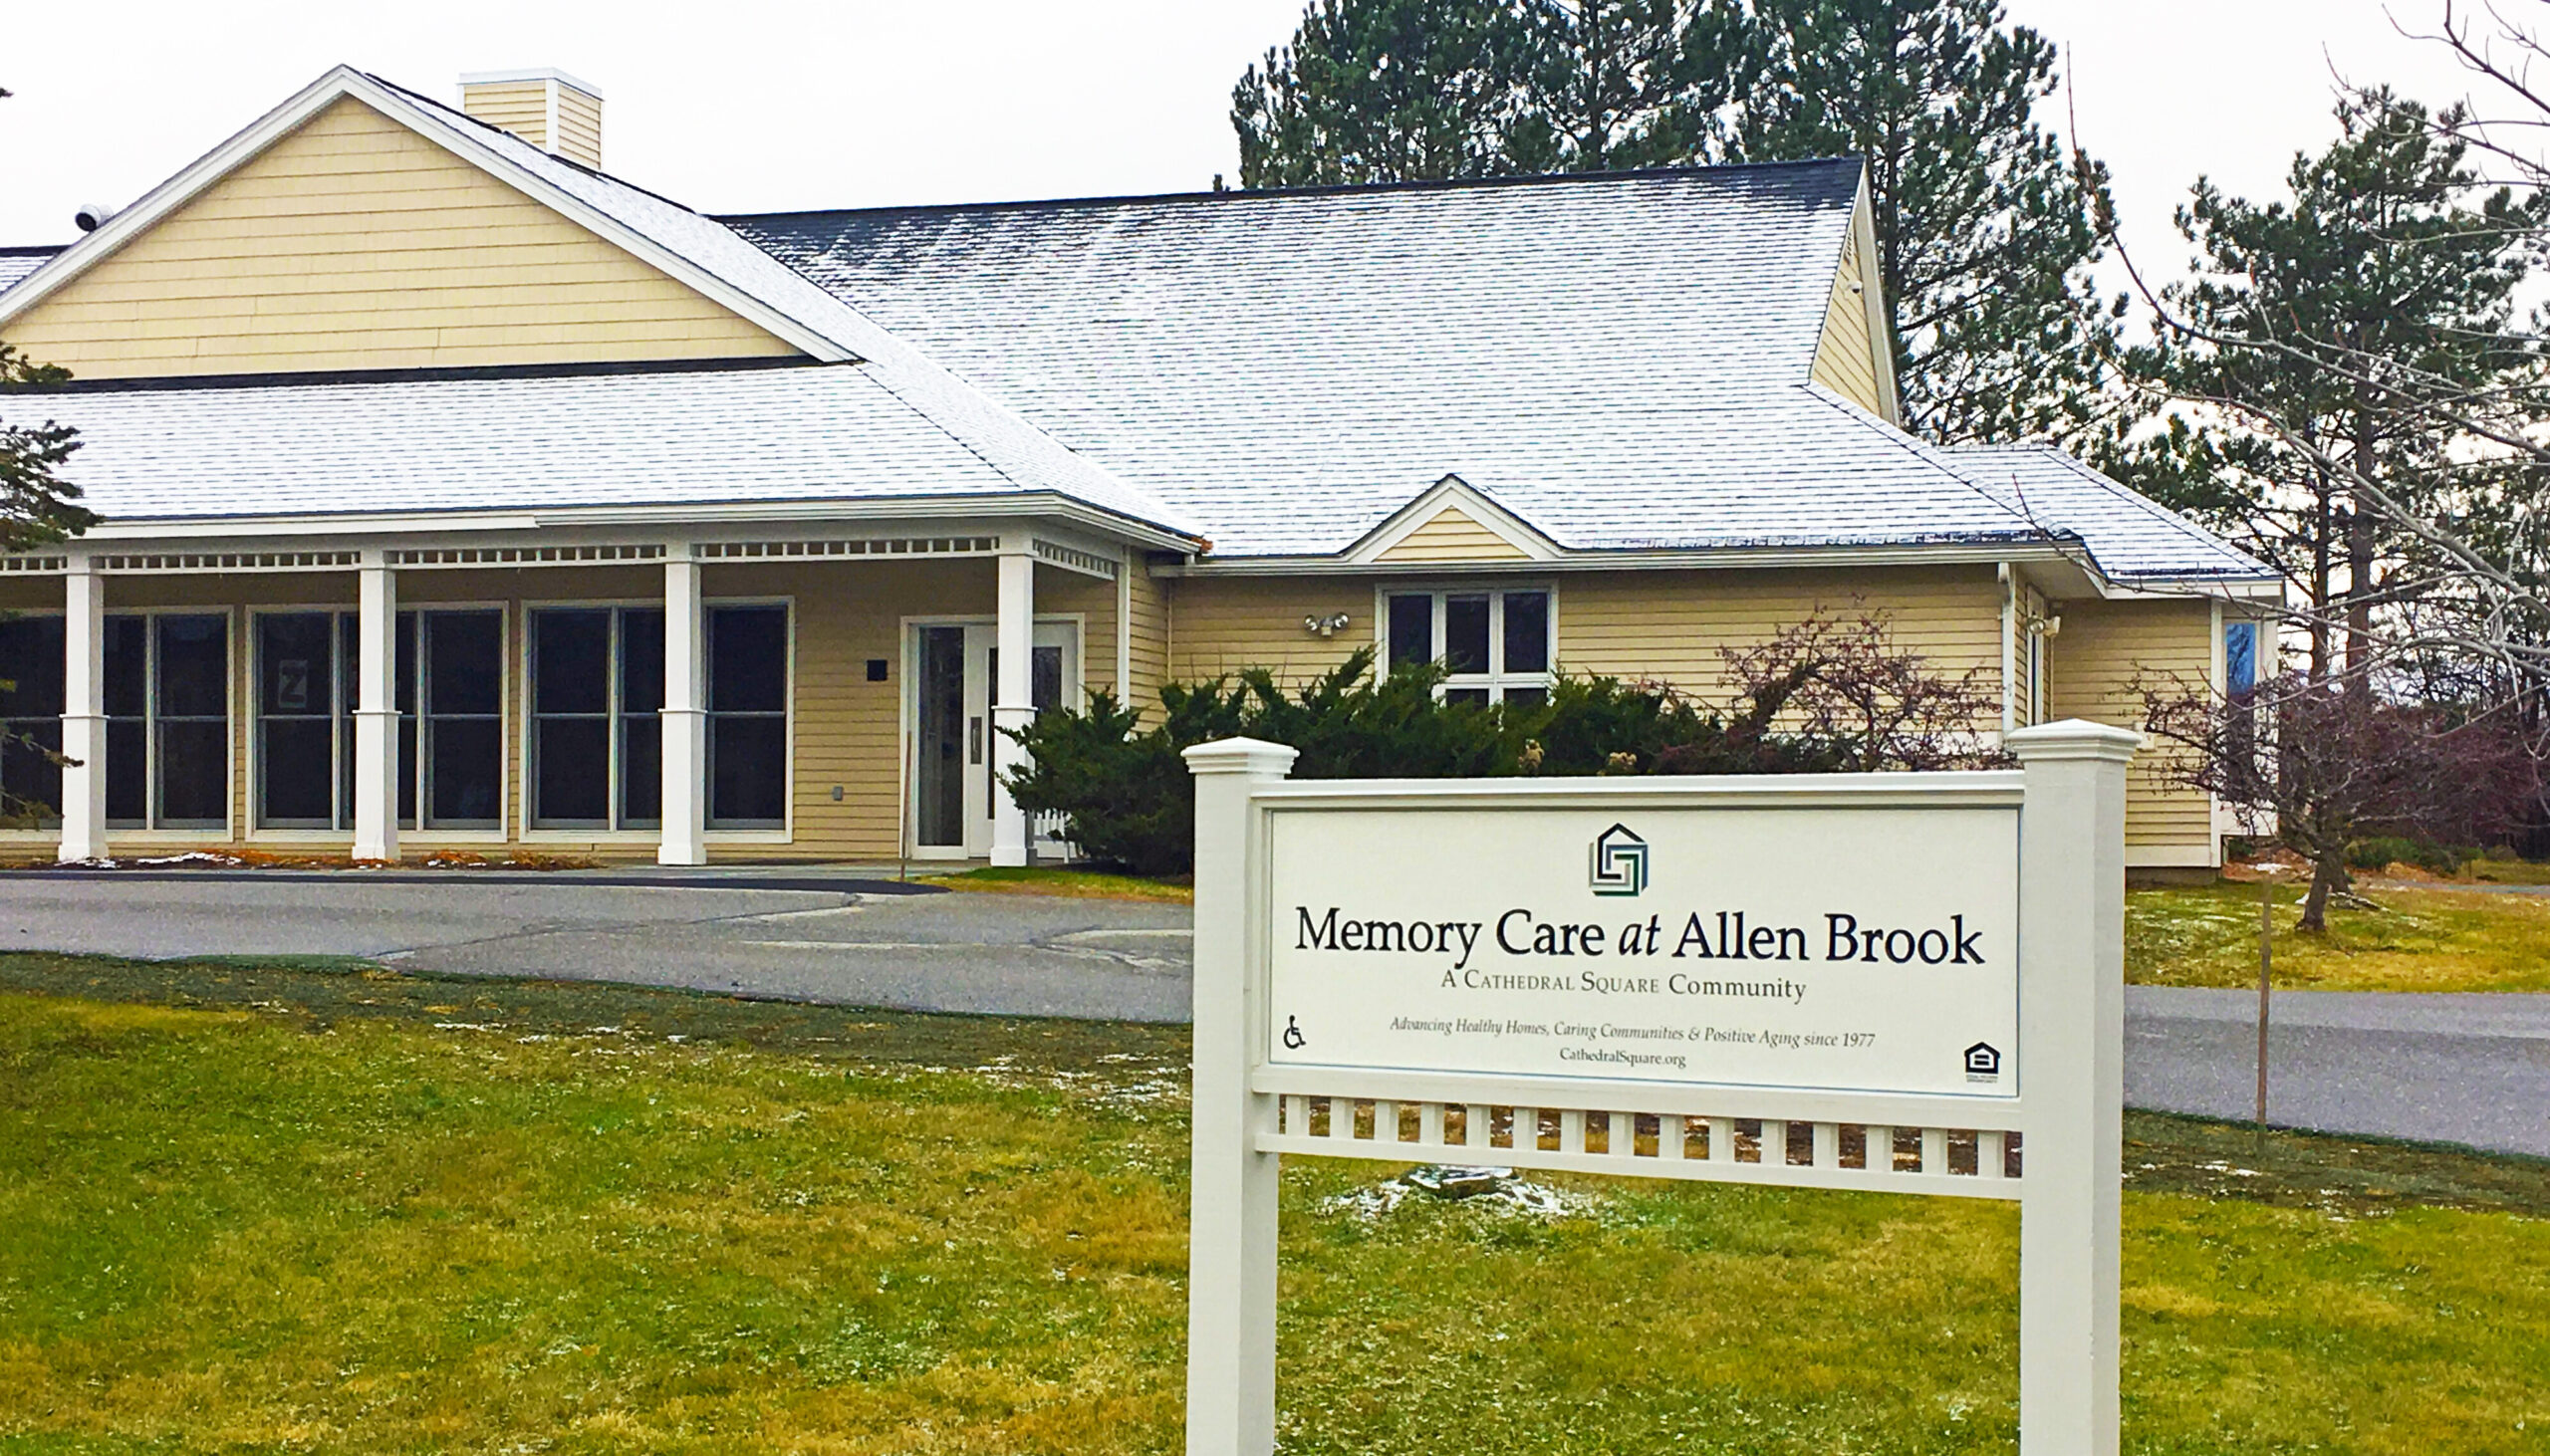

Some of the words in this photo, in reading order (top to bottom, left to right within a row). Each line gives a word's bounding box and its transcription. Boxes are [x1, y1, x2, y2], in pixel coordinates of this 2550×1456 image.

[1295, 906, 1482, 969] Memory
[1496, 908, 1606, 956] Care
[1619, 913, 1660, 956] at
[1671, 910, 1810, 960] Allen
[1824, 913, 1985, 965] Brook
[1440, 969, 1457, 988] A
[1464, 969, 1575, 991] CATHEDRAL
[1581, 971, 1659, 994] SQUARE
[1668, 973, 1807, 1005] Community
[1390, 1016, 1452, 1036] Advancing
[1456, 1018, 1502, 1038] Healthy
[1506, 1020, 1549, 1037] Homes,
[1554, 1021, 1597, 1040] Caring
[1601, 1023, 1684, 1041] Communities
[1687, 1027, 1700, 1042] &
[1704, 1027, 1756, 1044] Positive
[1758, 1029, 1800, 1049] Aging
[1804, 1031, 1839, 1047] since
[1842, 1032, 1876, 1048] 1977
[1559, 1047, 1686, 1069] CathedralSquare.org
